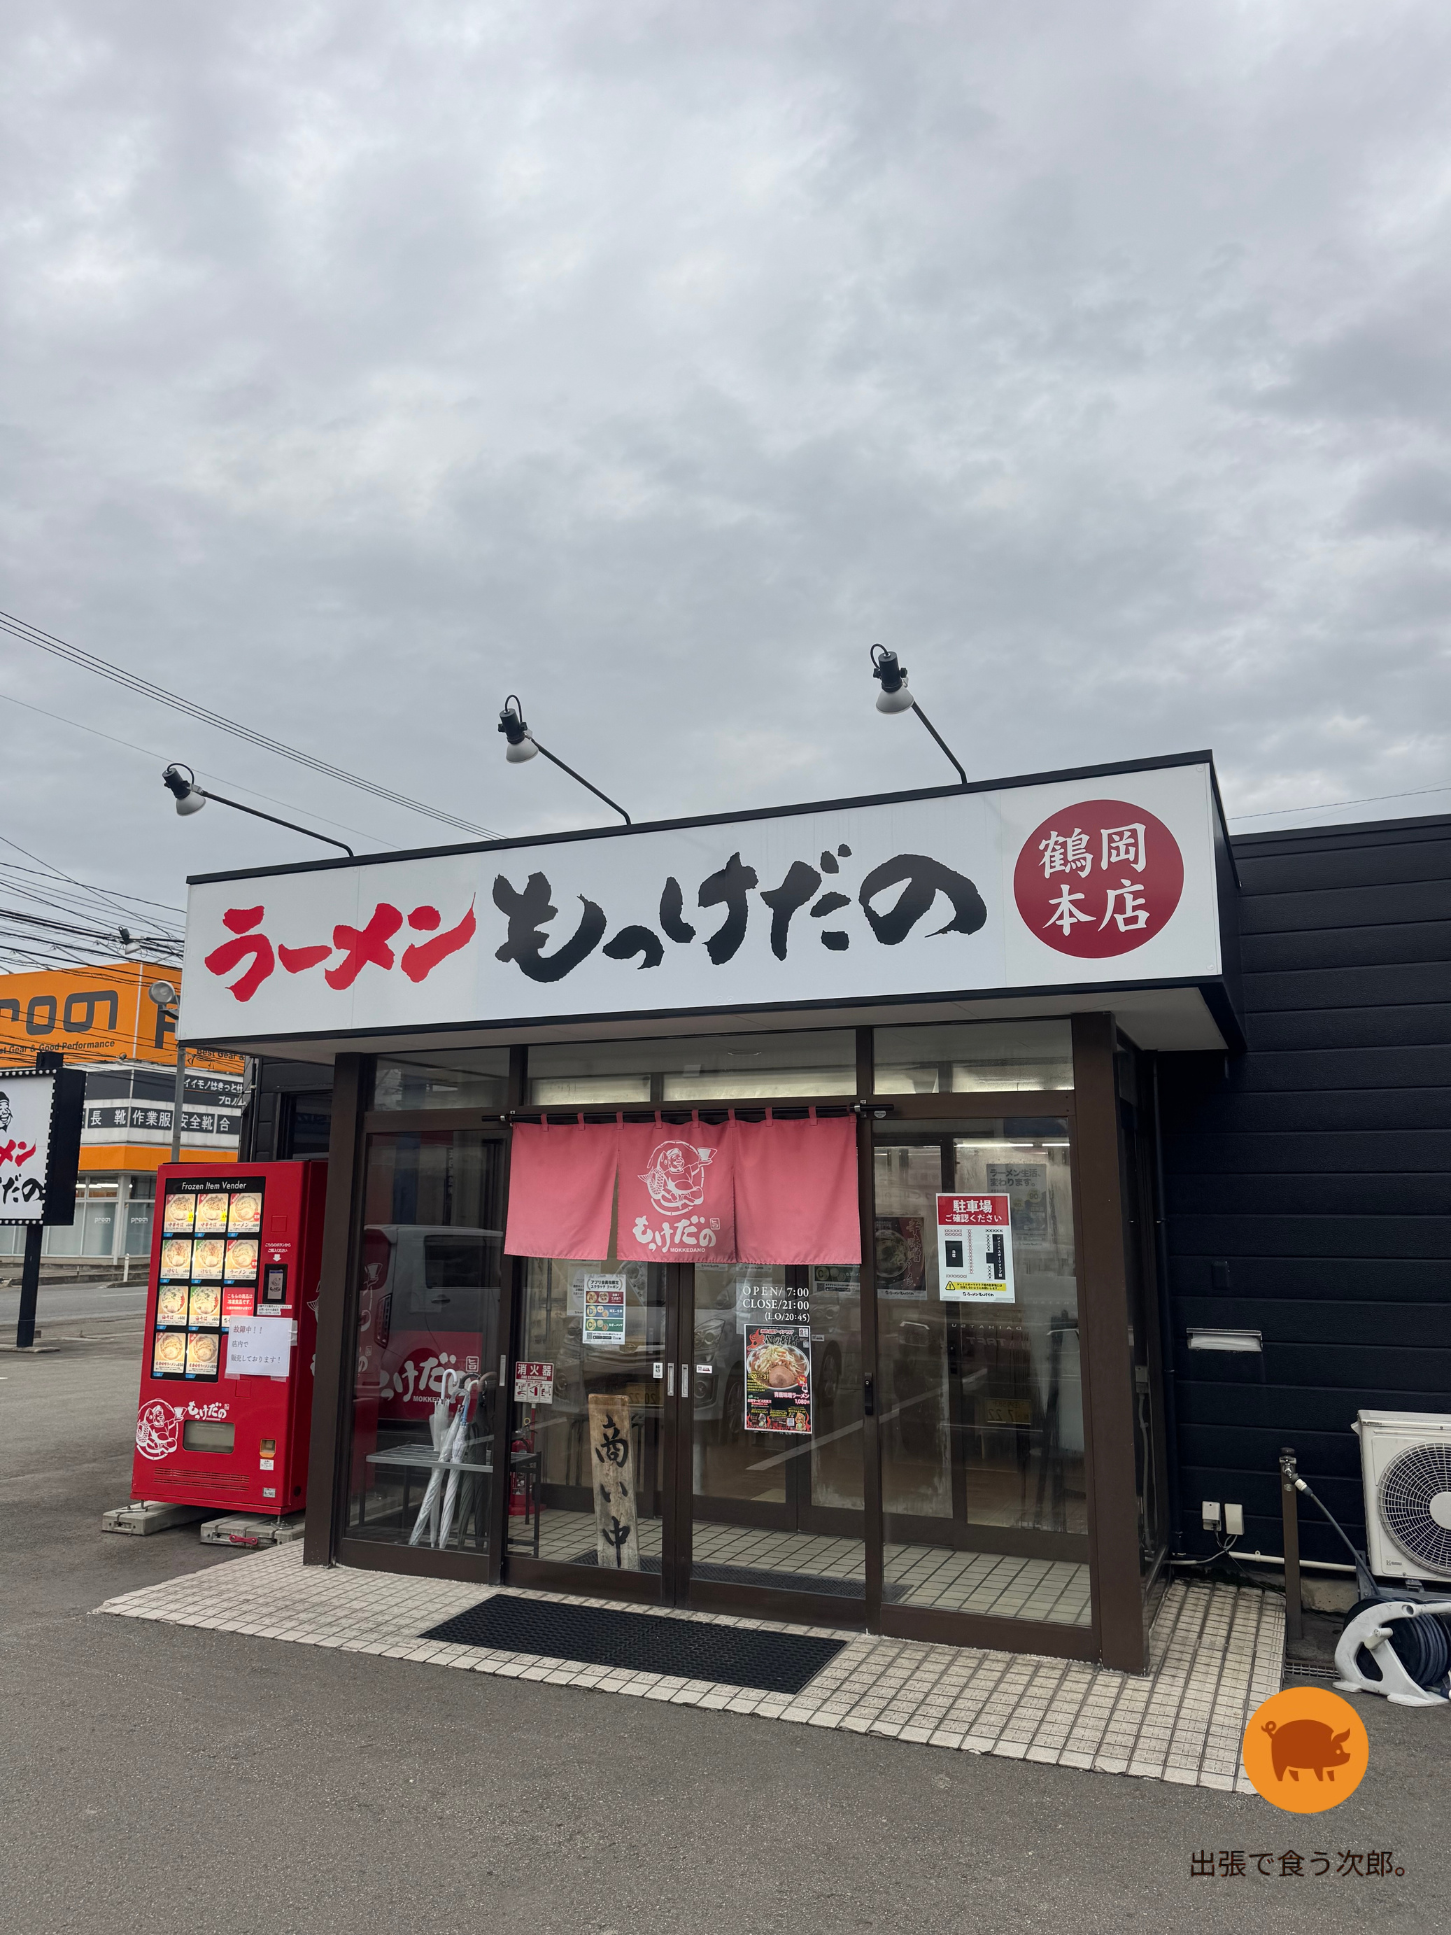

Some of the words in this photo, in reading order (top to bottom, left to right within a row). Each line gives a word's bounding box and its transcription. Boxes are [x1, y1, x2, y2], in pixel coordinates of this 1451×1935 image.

[1038, 823, 1147, 879] 鶴岡
[1043, 879, 1151, 936] 本店
[205, 892, 476, 1002] ラーメン
[493, 844, 987, 982] もっけだの
[62, 1040, 116, 1051] Performance
[133, 1109, 172, 1128] 作業服
[181, 1112, 214, 1131] 安全靴
[182, 1181, 204, 1190] Frozen
[206, 1181, 220, 1190] Item
[222, 1181, 247, 1189] Vender
[953, 1199, 993, 1213] 駐車場
[945, 1213, 1002, 1223] ご確認ください
[632, 1215, 717, 1253] もっけだの
[742, 1286, 783, 1296] OPEN/
[787, 1287, 810, 1297] 7:00
[742, 1299, 810, 1310] CLOSE/21:00
[518, 1363, 552, 1377] 消火器
